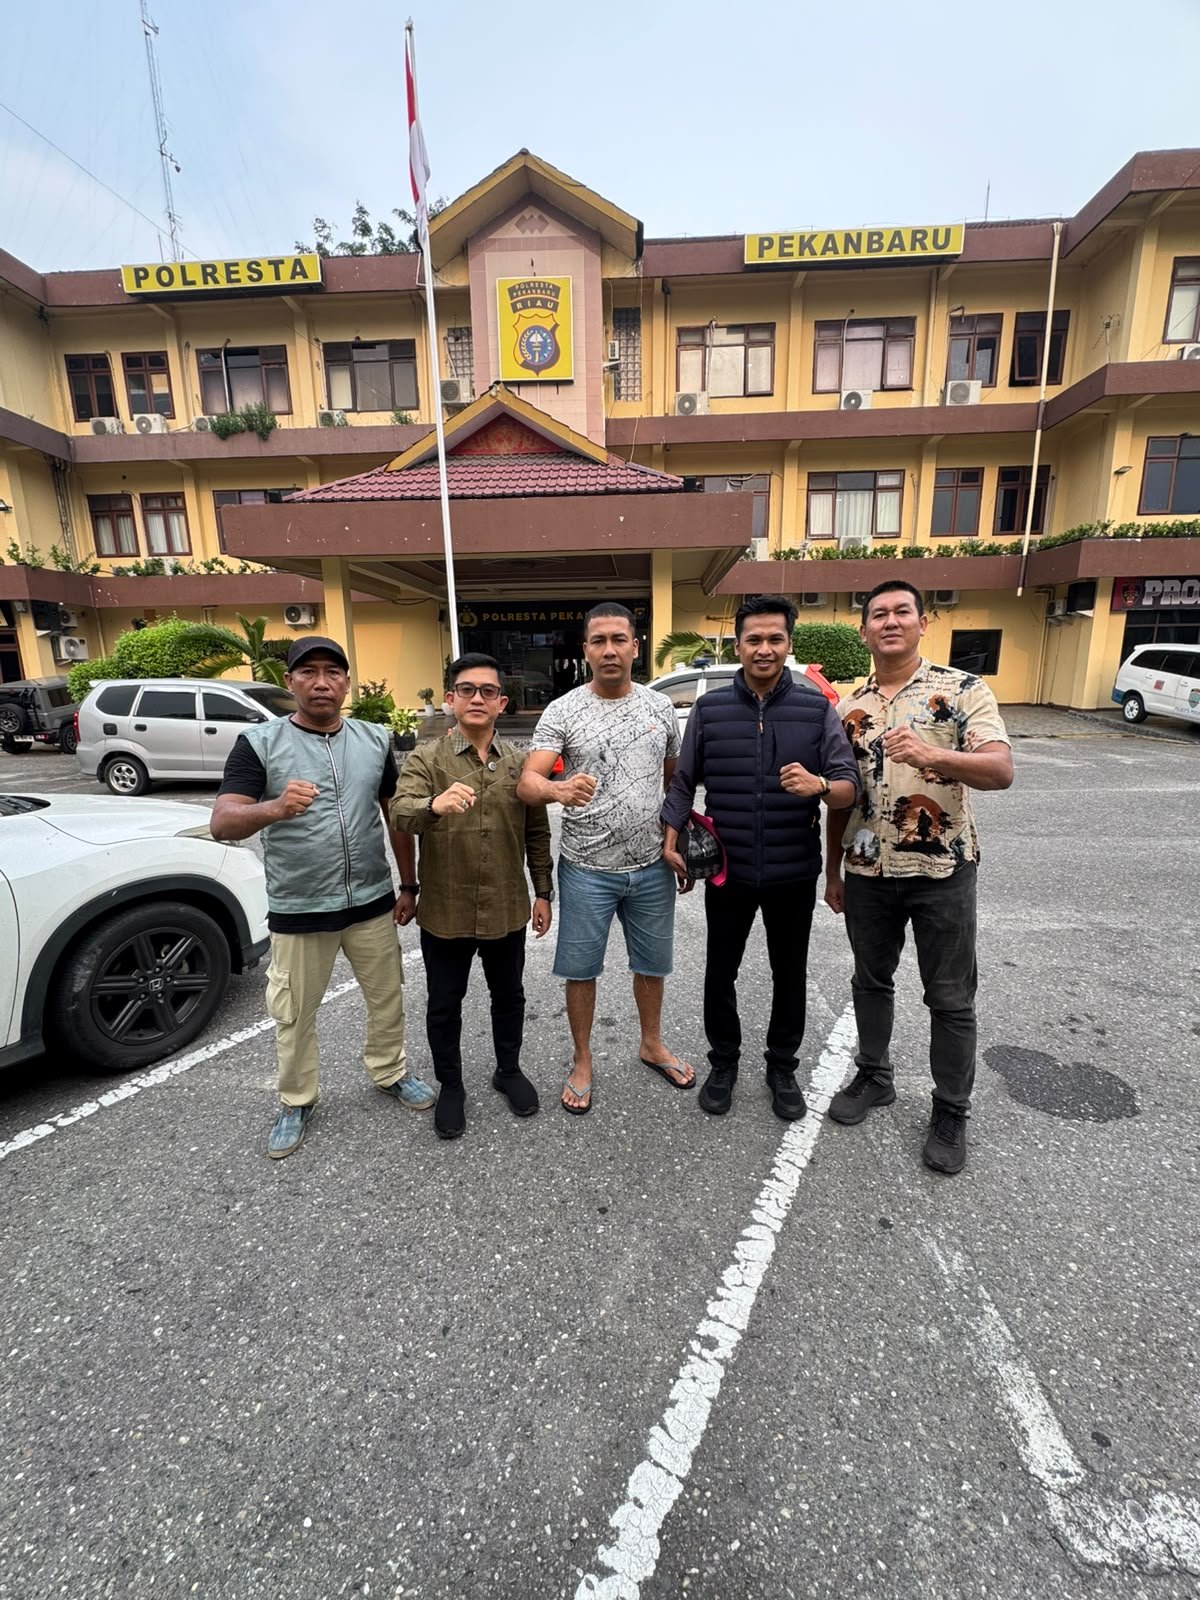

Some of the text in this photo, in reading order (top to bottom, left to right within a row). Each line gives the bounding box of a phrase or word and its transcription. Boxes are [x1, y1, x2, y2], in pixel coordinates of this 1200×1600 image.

[758, 228, 951, 258] PEKANBARU
[134, 258, 309, 288] POLRESTA
[515, 282, 553, 290] POLRESTA
[513, 289, 555, 297] PEKANBARU
[516, 300, 554, 309] RIAU
[1142, 579, 1200, 606] PRO
[483, 611, 587, 621] POLRESTA PEKA
